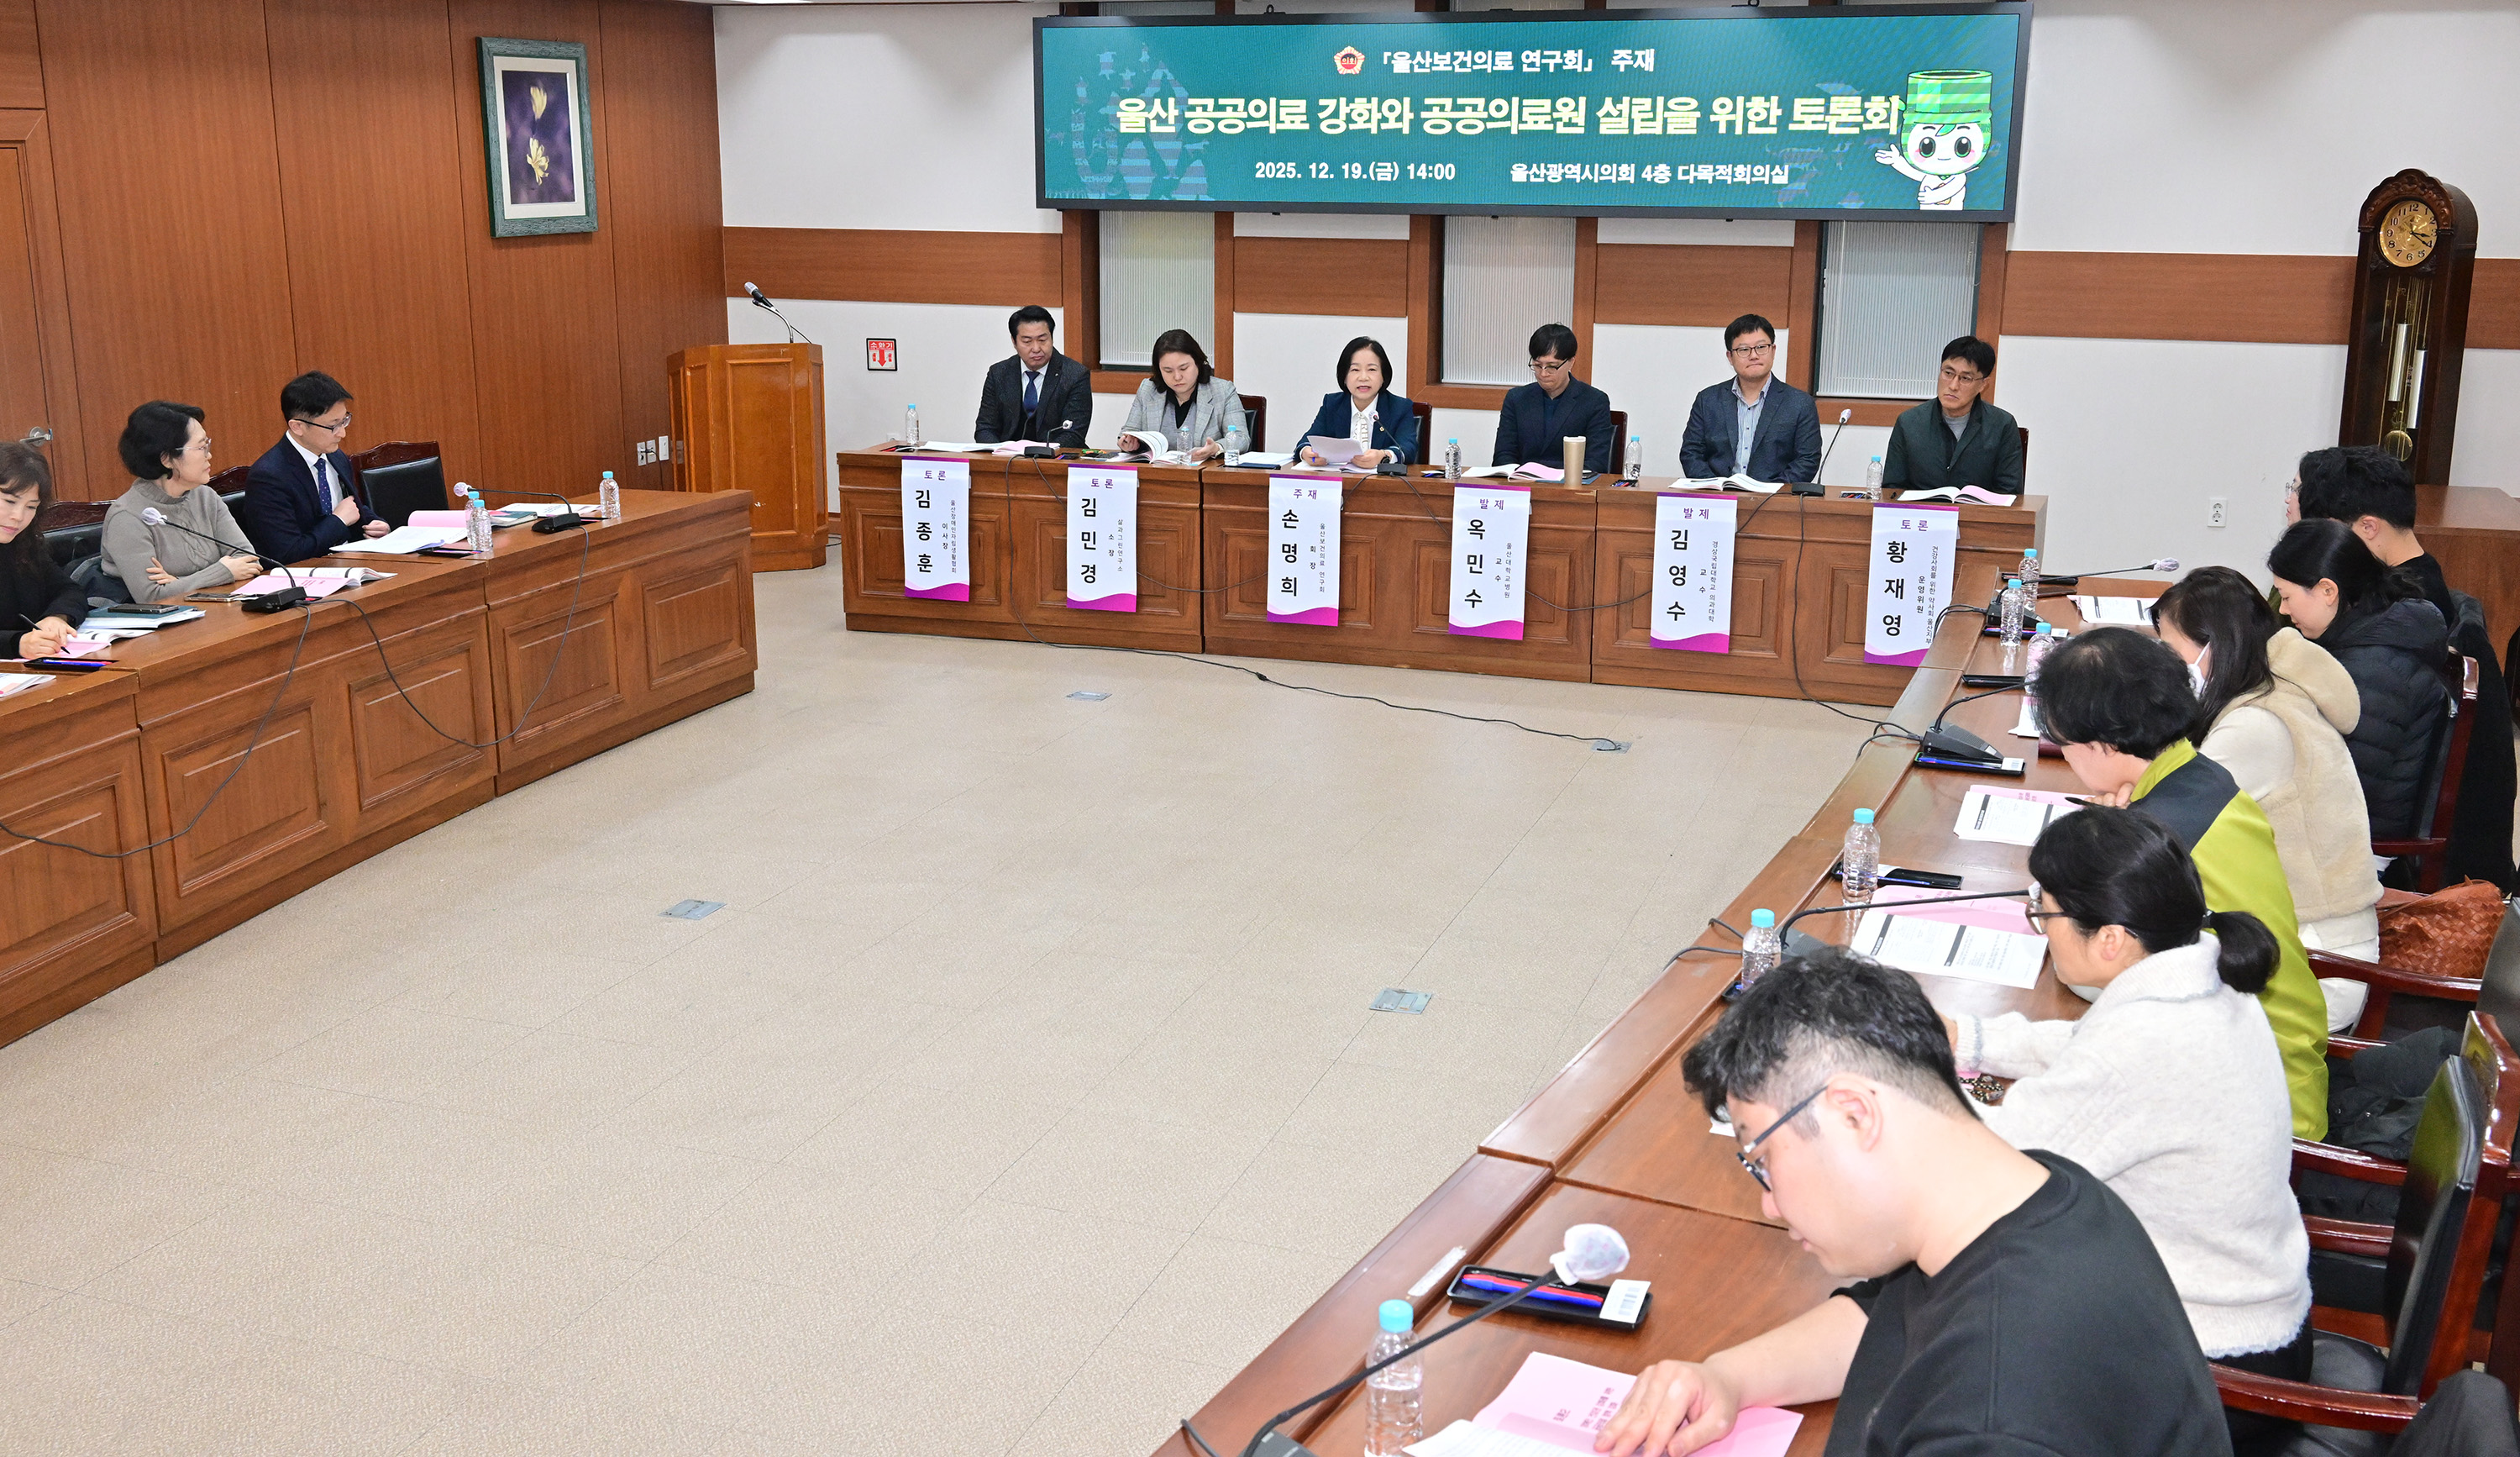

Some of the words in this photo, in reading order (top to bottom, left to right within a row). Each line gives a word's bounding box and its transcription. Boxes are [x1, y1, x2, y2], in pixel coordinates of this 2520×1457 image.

[1611, 48, 1655, 72] 주재
[1116, 97, 1179, 133] 울산
[1184, 97, 1310, 134] 공공의료
[1317, 97, 1415, 134] 강화와
[1420, 96, 1587, 135] 공공의료원
[1596, 96, 1701, 135] 설립을
[1709, 95, 1782, 135] 위한
[1788, 95, 1900, 135] 토론회
[1255, 161, 1302, 179] 2025.
[1309, 162, 1334, 179] 12.
[1341, 161, 1399, 181] 19.(금)
[1407, 163, 1456, 181] 14:00
[1510, 163, 1635, 184] 울산광역시의회
[1641, 163, 1672, 184] 4층
[1677, 163, 1789, 185] 다목적회의실
[2409, 203, 2419, 212] 12
[2390, 218, 2398, 226] 10
[2407, 253, 2413, 261] 6
[2418, 250, 2425, 258] 5
[924, 470, 946, 481] 토론
[1090, 478, 1114, 489] 토론
[1293, 488, 1318, 500] 주재
[1479, 498, 1504, 510] 발제
[1683, 508, 1709, 520] 발제
[1900, 519, 1929, 532] 토론
[915, 489, 933, 573] 김종훈
[1080, 497, 1096, 584] 김민경
[1108, 534, 1115, 557] 소장
[1280, 508, 1299, 597] 손명희
[1310, 545, 1316, 570] 회장
[1464, 518, 1486, 608] 옥민수
[1709, 540, 1718, 591] 경상국립대학교
[1494, 558, 1503, 582] 교수
[1504, 542, 1512, 599] 울산대학교병원
[1667, 529, 1688, 622] 김영수
[1698, 568, 1707, 594] 교수
[1882, 540, 1908, 637] 황재영
[1916, 576, 1925, 614] 운영위원
[1929, 581, 1936, 595] 위한
[1927, 597, 1935, 618] 약사회
